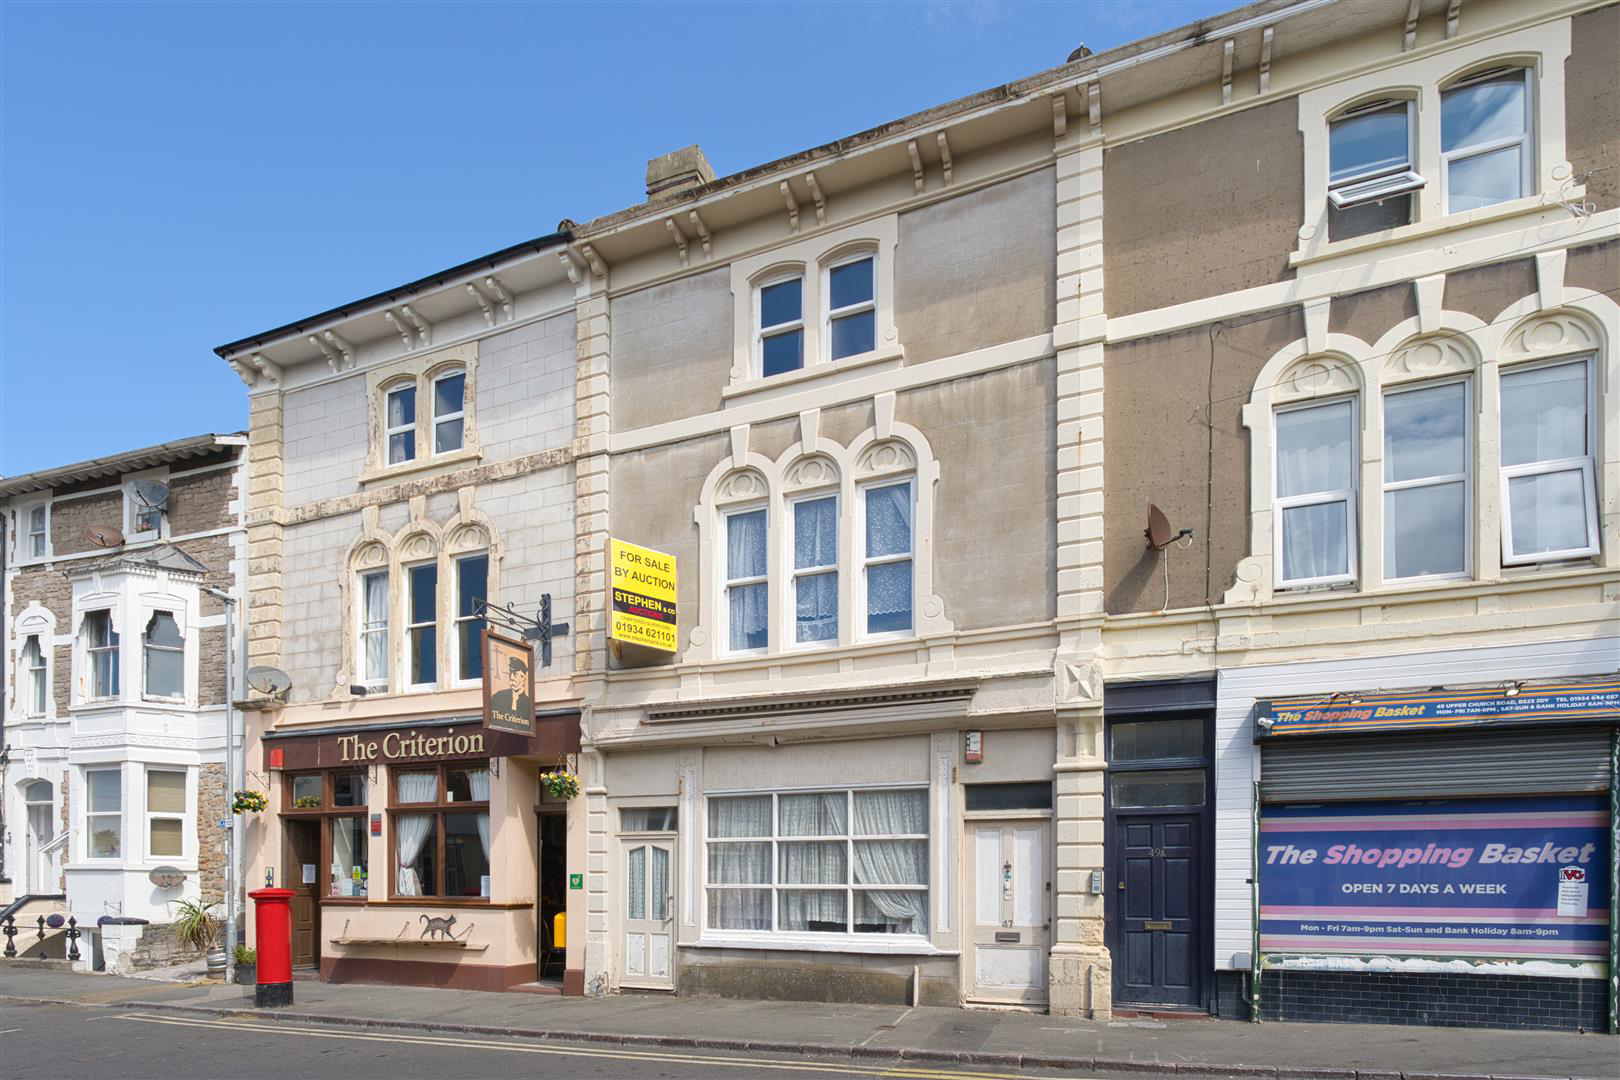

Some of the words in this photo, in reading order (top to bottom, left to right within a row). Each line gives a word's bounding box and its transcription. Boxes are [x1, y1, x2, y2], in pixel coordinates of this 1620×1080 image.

[620, 550, 642, 565] FOR
[644, 557, 670, 573] SALE
[614, 566, 629, 578] BY
[631, 571, 675, 591] AUCTION
[614, 591, 662, 611] STEPHEN
[616, 621, 643, 635] 01934
[646, 627, 675, 642] 621101
[492, 710, 505, 720] The
[504, 712, 530, 726] Criterion
[1277, 712, 1302, 722] The
[1304, 709, 1373, 721] Shopping
[1374, 705, 1426, 717] Basket
[337, 734, 378, 761] The
[382, 728, 485, 758] Criterion
[1148, 847, 1167, 857] 49A
[1266, 845, 1318, 864] The
[1322, 843, 1474, 868] Shopping
[1478, 842, 1597, 864] Basket
[1341, 883, 1383, 894] OPEN
[1387, 883, 1396, 894] 7
[1400, 883, 1439, 894] DAYS
[1443, 884, 1455, 894] A
[1459, 883, 1507, 894] WEEK
[1001, 919, 1014, 928] 47
[1327, 924, 1339, 932] Fri
[1341, 924, 1384, 933] 7am-9pm
[1424, 926, 1443, 934] and
[1471, 927, 1508, 936] Holiday
[1510, 928, 1559, 936] 8am-9pm
